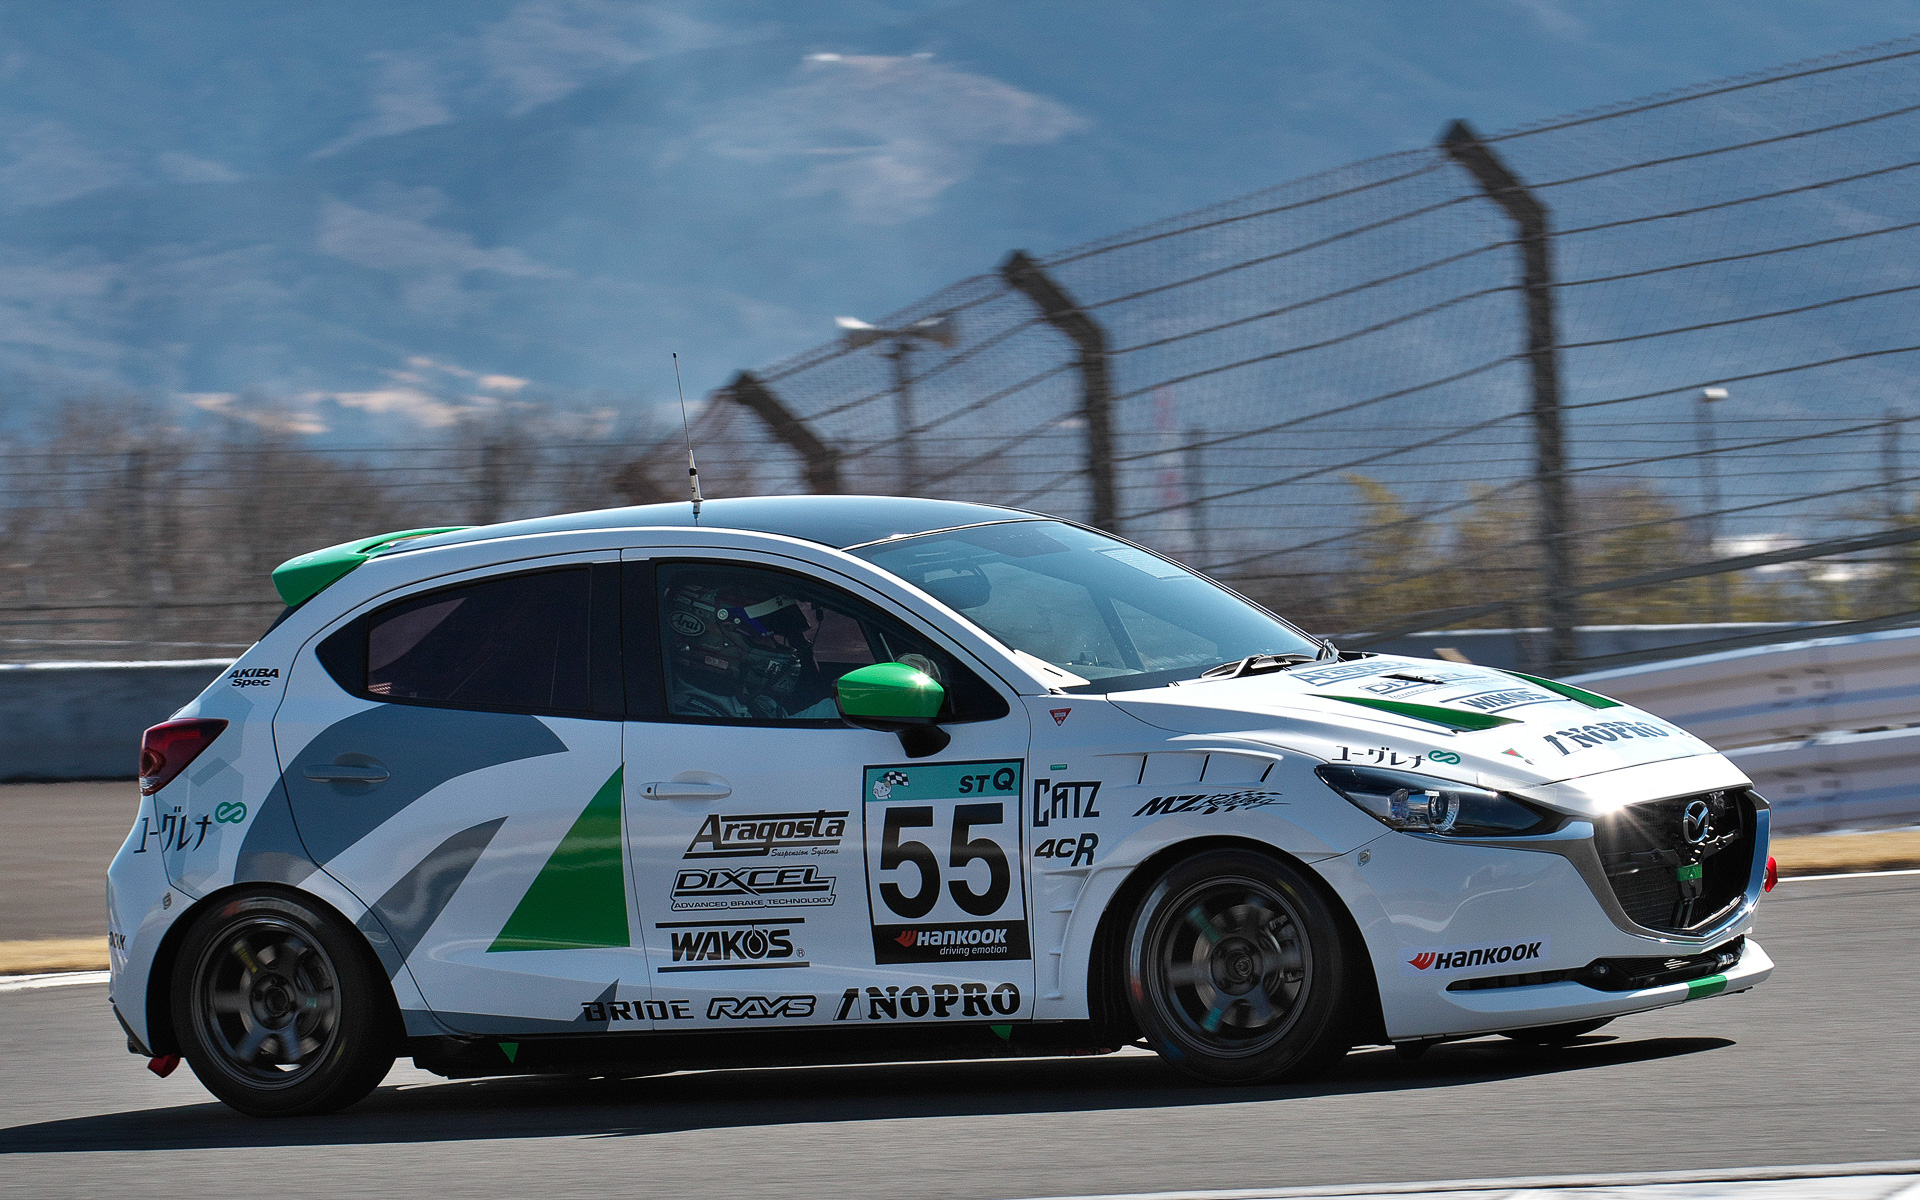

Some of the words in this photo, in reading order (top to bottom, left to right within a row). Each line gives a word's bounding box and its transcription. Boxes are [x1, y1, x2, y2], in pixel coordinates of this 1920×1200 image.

[673, 615, 702, 631] Arai
[228, 668, 280, 679] AKIBA
[231, 679, 271, 688] Spec
[1331, 746, 1426, 769] ユーグレナ
[1033, 779, 1102, 827] CATZ
[133, 806, 212, 854] ユーグレナ
[686, 810, 847, 856] Aragosta
[771, 849, 808, 858] Suspension
[811, 847, 839, 857] Systems
[879, 803, 1011, 919] 55
[676, 868, 830, 896] DIXCEL
[674, 901, 728, 909] ADVANCED
[730, 899, 764, 907] BRAKE
[767, 897, 833, 905] TECHNOLOGY
[671, 928, 794, 962] WAKO'S
[917, 928, 1008, 947] HANKOOK
[940, 947, 970, 957] driving
[972, 945, 1008, 955] emotion
[1434, 941, 1542, 970] HANKOOK
[581, 1000, 694, 1021] BRIDE
[706, 995, 817, 1019] RAYS
